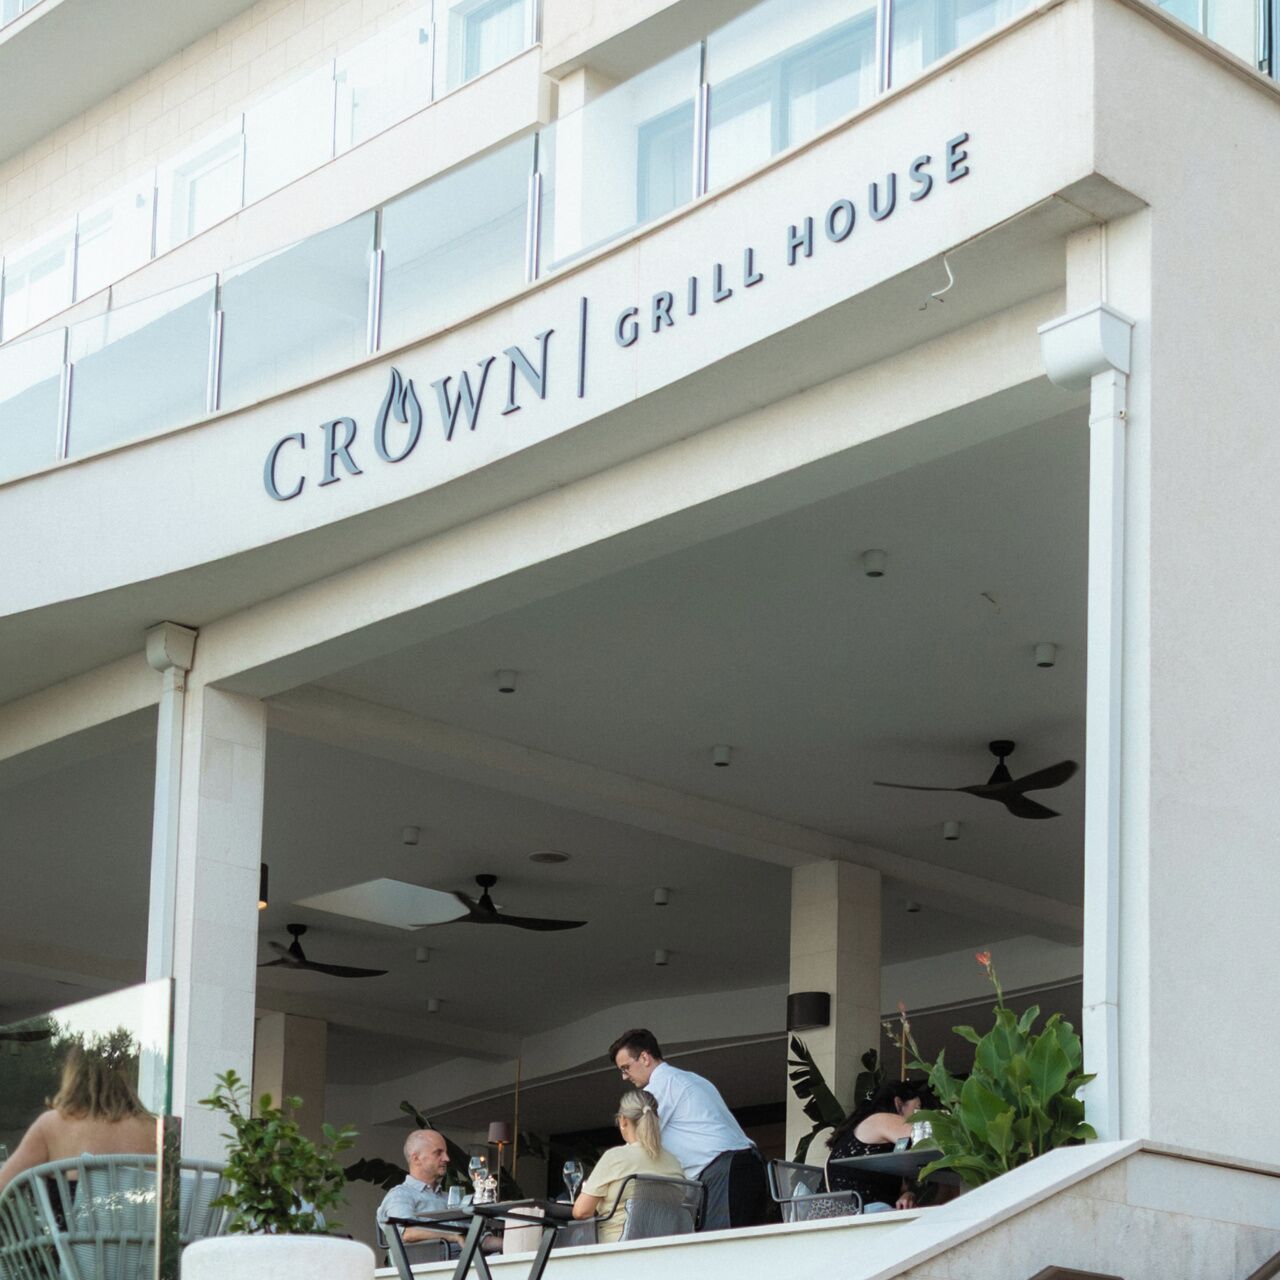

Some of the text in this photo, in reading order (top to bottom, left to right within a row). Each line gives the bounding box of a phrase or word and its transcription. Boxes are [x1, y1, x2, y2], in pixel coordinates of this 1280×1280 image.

[262, 131, 971, 502] CROWN GRILL HOUSE
